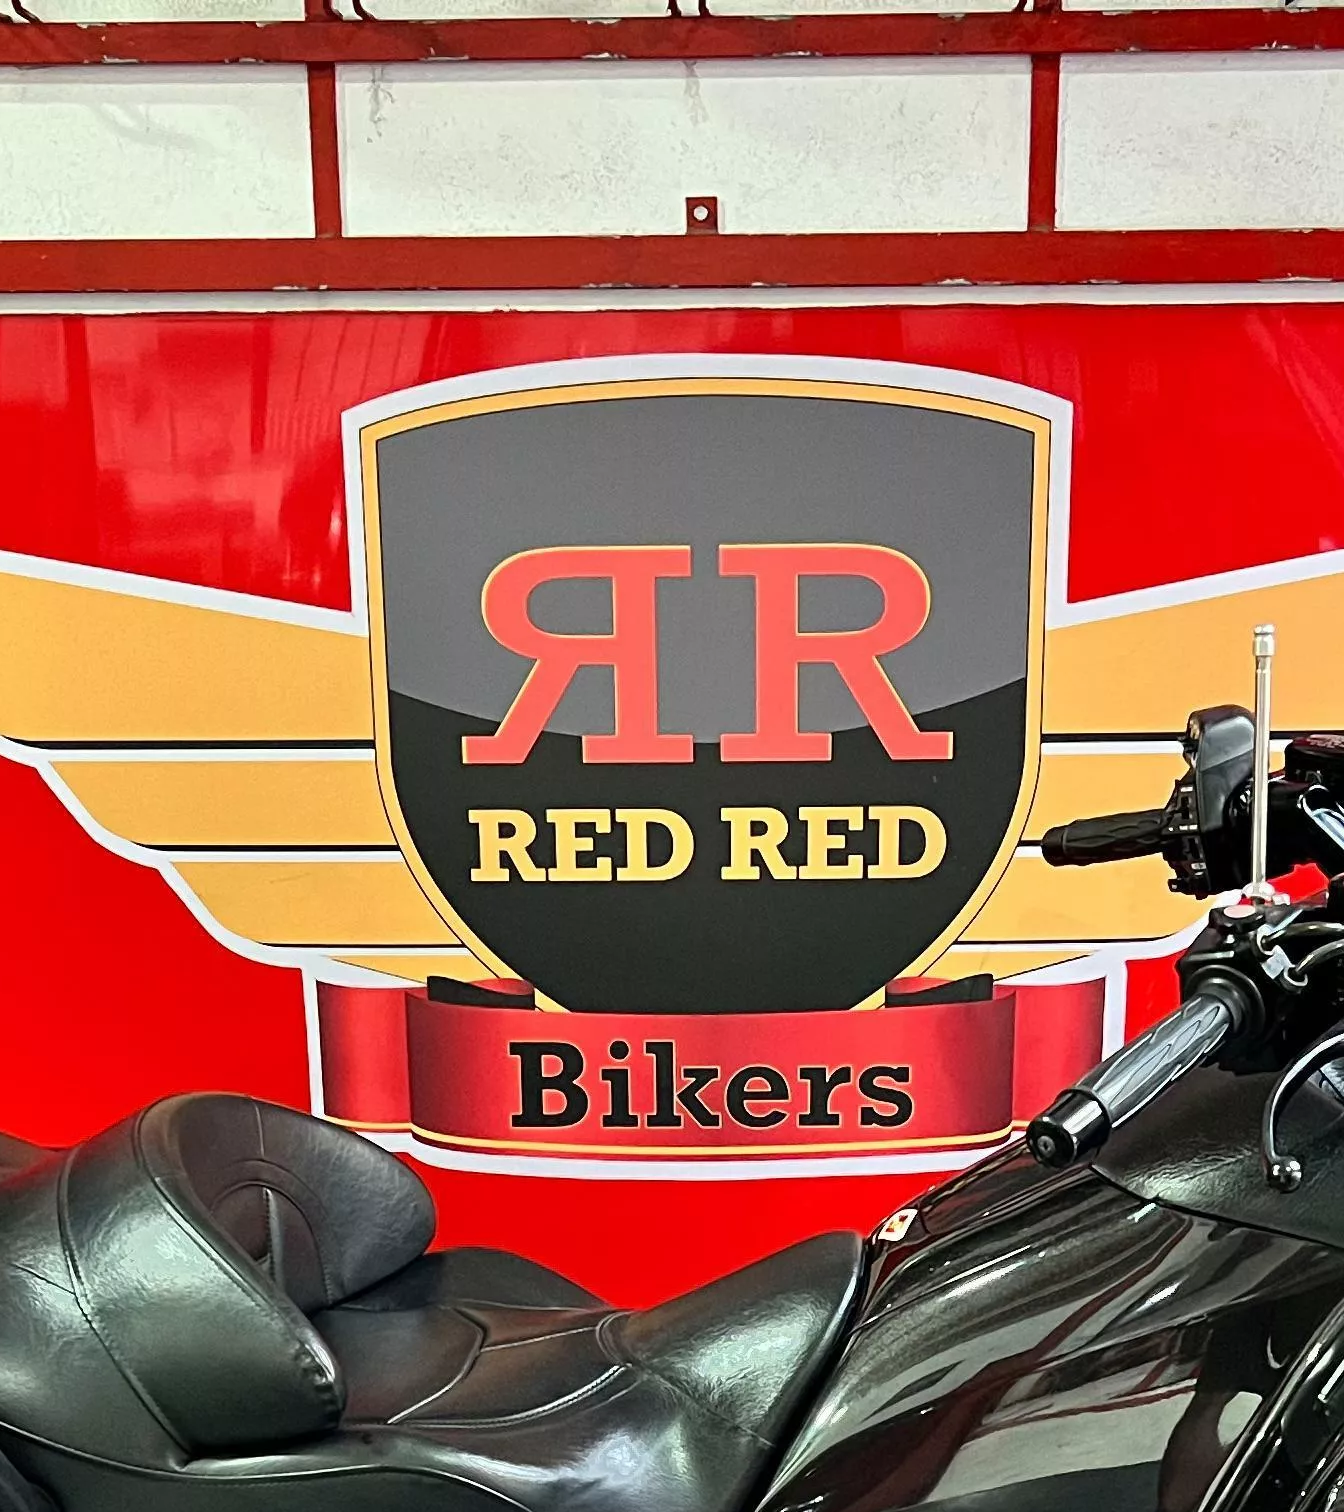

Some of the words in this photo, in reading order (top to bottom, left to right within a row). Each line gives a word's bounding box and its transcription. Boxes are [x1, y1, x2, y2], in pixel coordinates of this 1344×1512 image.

[468, 808, 695, 882] RED
[720, 805, 948, 881] RED
[509, 1041, 914, 1129] Bikers
